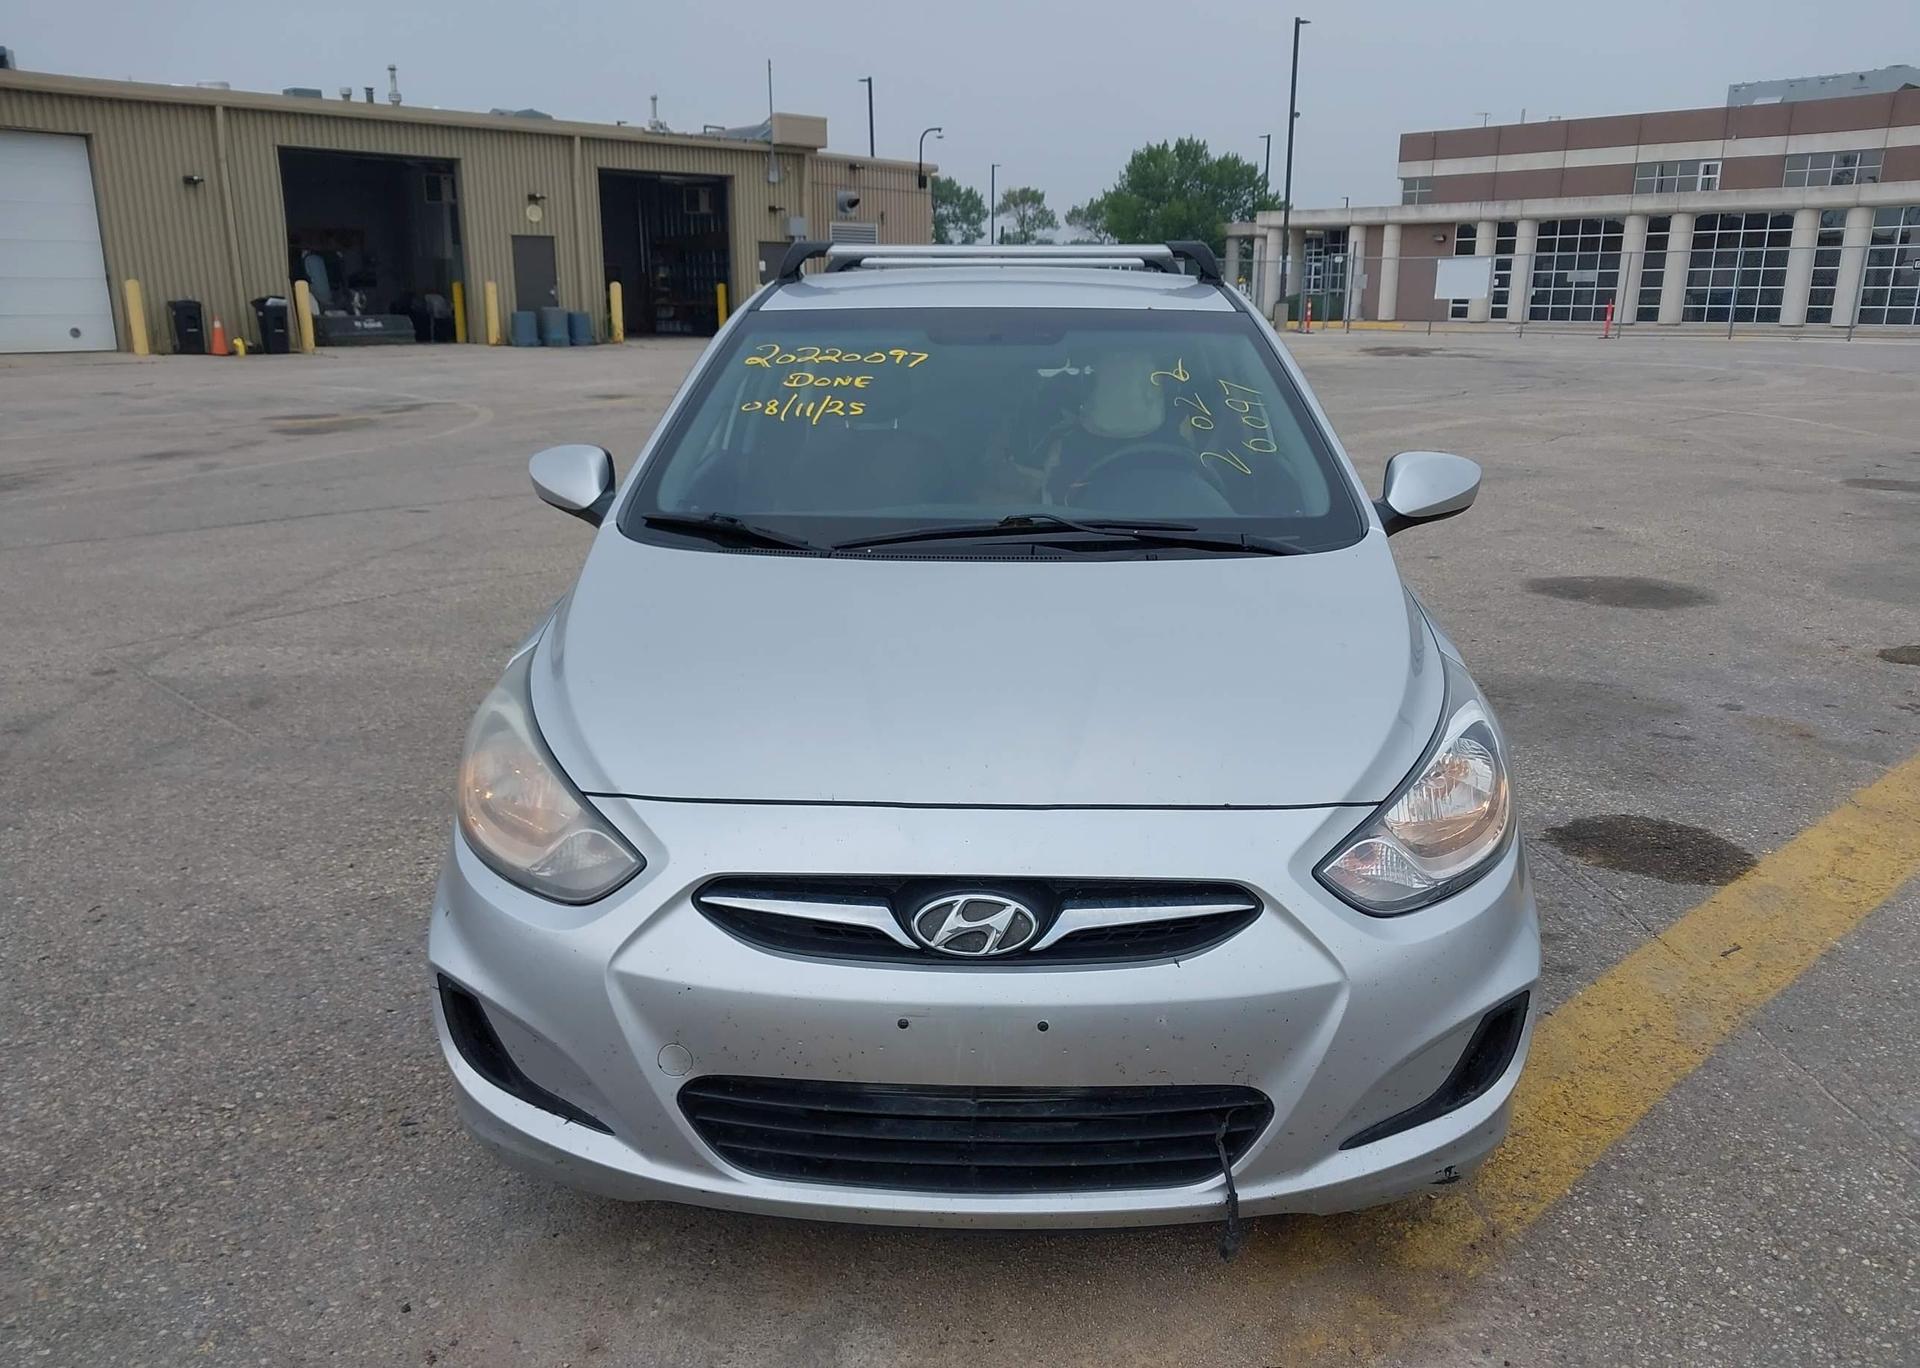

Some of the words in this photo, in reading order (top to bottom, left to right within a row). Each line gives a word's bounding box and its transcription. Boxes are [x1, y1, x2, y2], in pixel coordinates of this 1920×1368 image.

[744, 343, 929, 368] 20220097
[782, 371, 875, 388] DONE
[740, 392, 867, 425] 08/11/25
